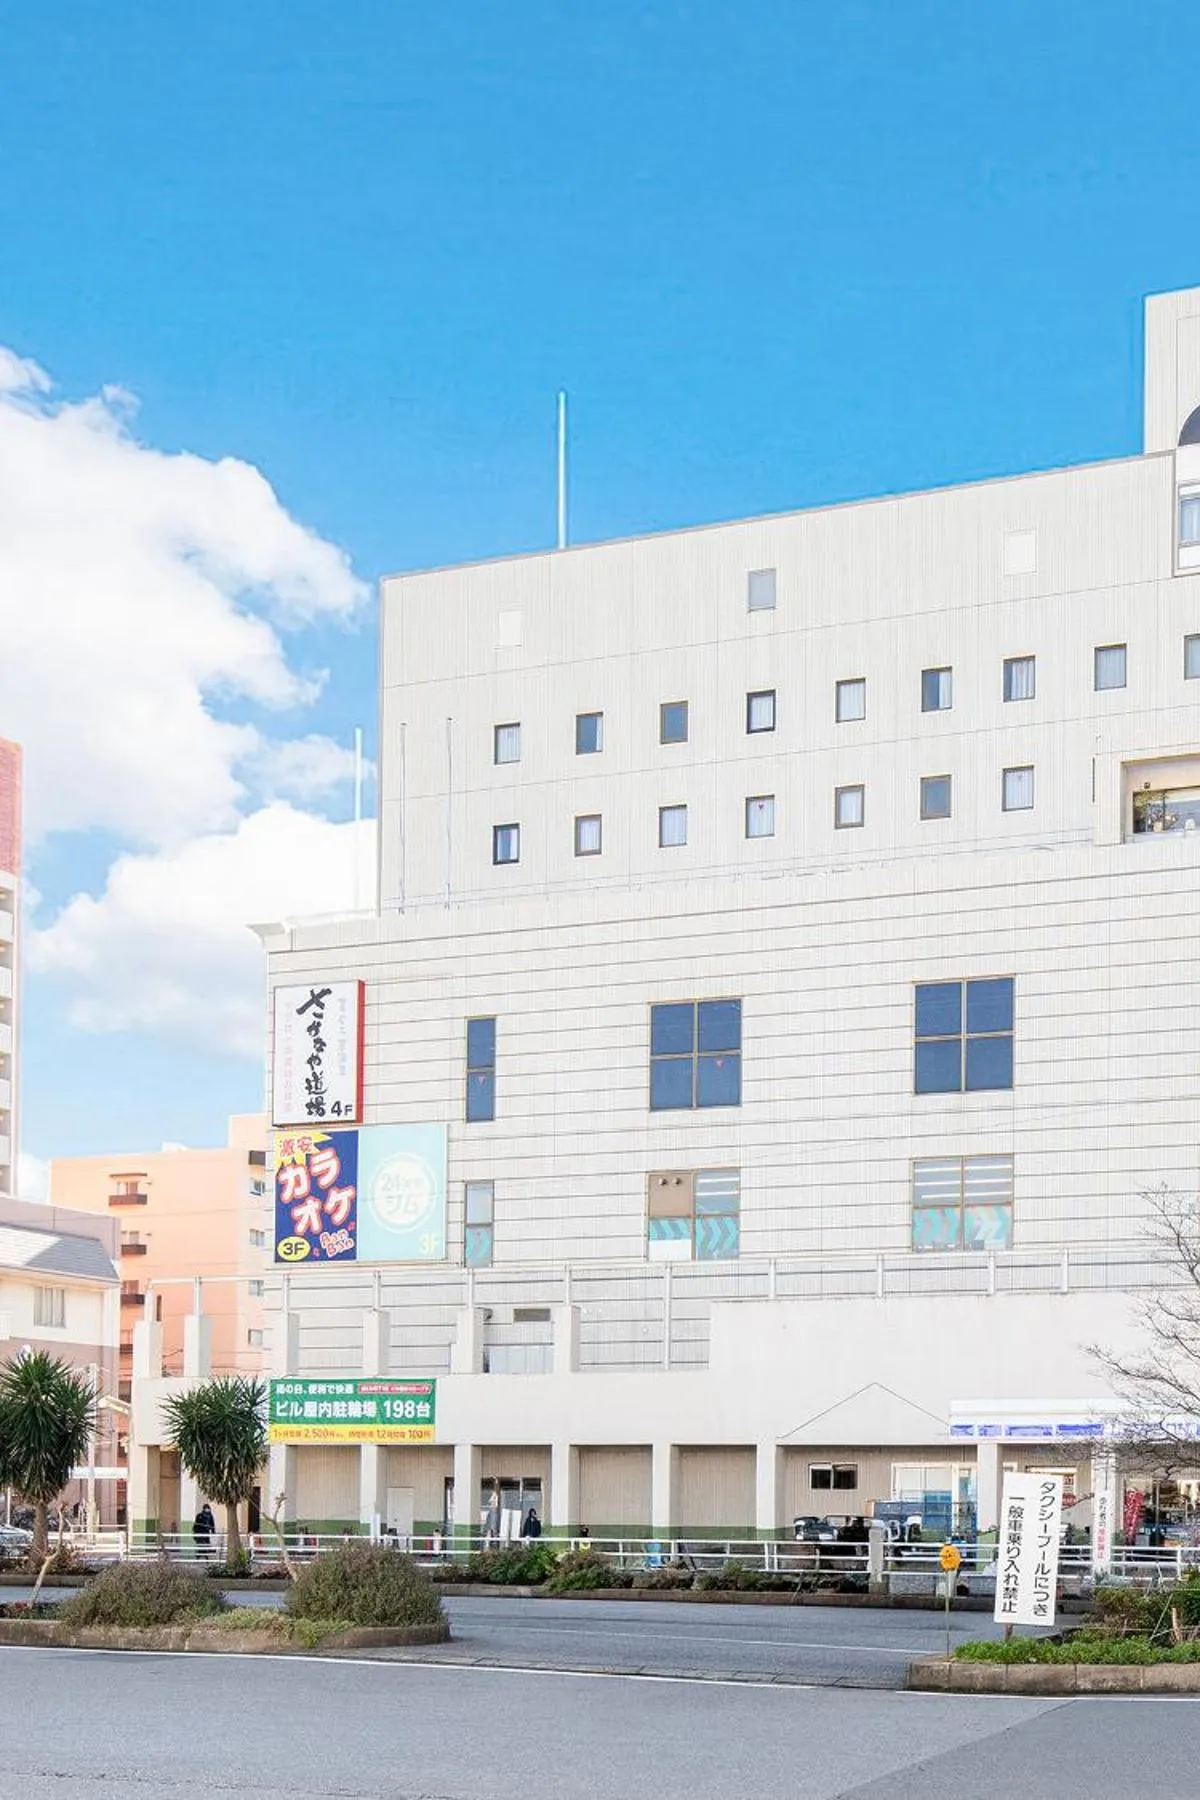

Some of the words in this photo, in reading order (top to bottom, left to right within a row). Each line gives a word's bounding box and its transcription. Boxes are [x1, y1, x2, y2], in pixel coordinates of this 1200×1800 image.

[296, 987, 332, 1117] さかなや道場
[331, 1100, 353, 1117] 4F
[283, 1241, 305, 1256] 3F
[383, 1400, 431, 1418] 198台
[1002, 1496, 1025, 1614] 一般車乗り入れ禁止
[1033, 1481, 1057, 1617] タクシープールにつき
